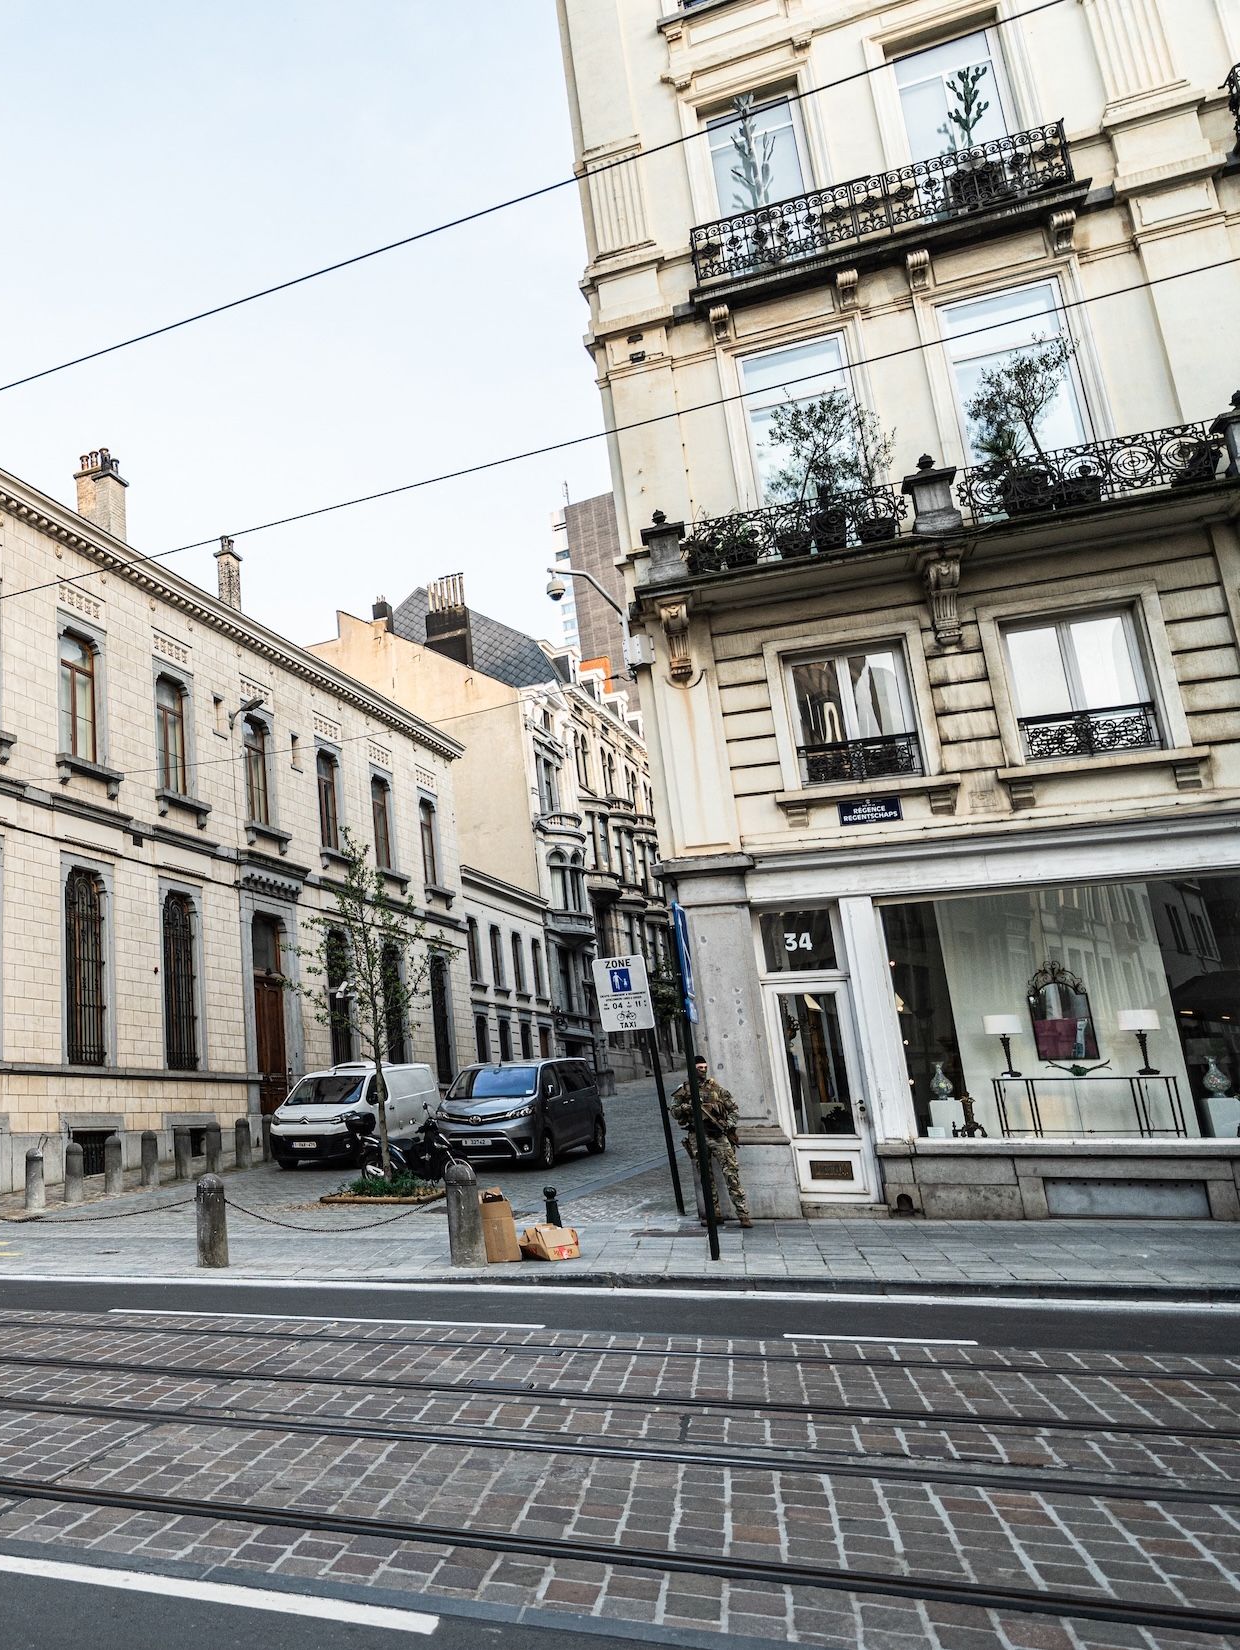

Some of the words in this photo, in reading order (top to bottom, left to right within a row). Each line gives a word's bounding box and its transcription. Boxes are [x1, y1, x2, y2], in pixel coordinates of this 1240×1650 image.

[853, 805, 886, 814] RÉGENCE
[843, 811, 898, 822] REGENTSCHAPS
[783, 932, 813, 951] 34
[604, 959, 632, 969] ZONE
[612, 1002, 623, 1010] 04
[619, 1021, 637, 1029] TAXI
